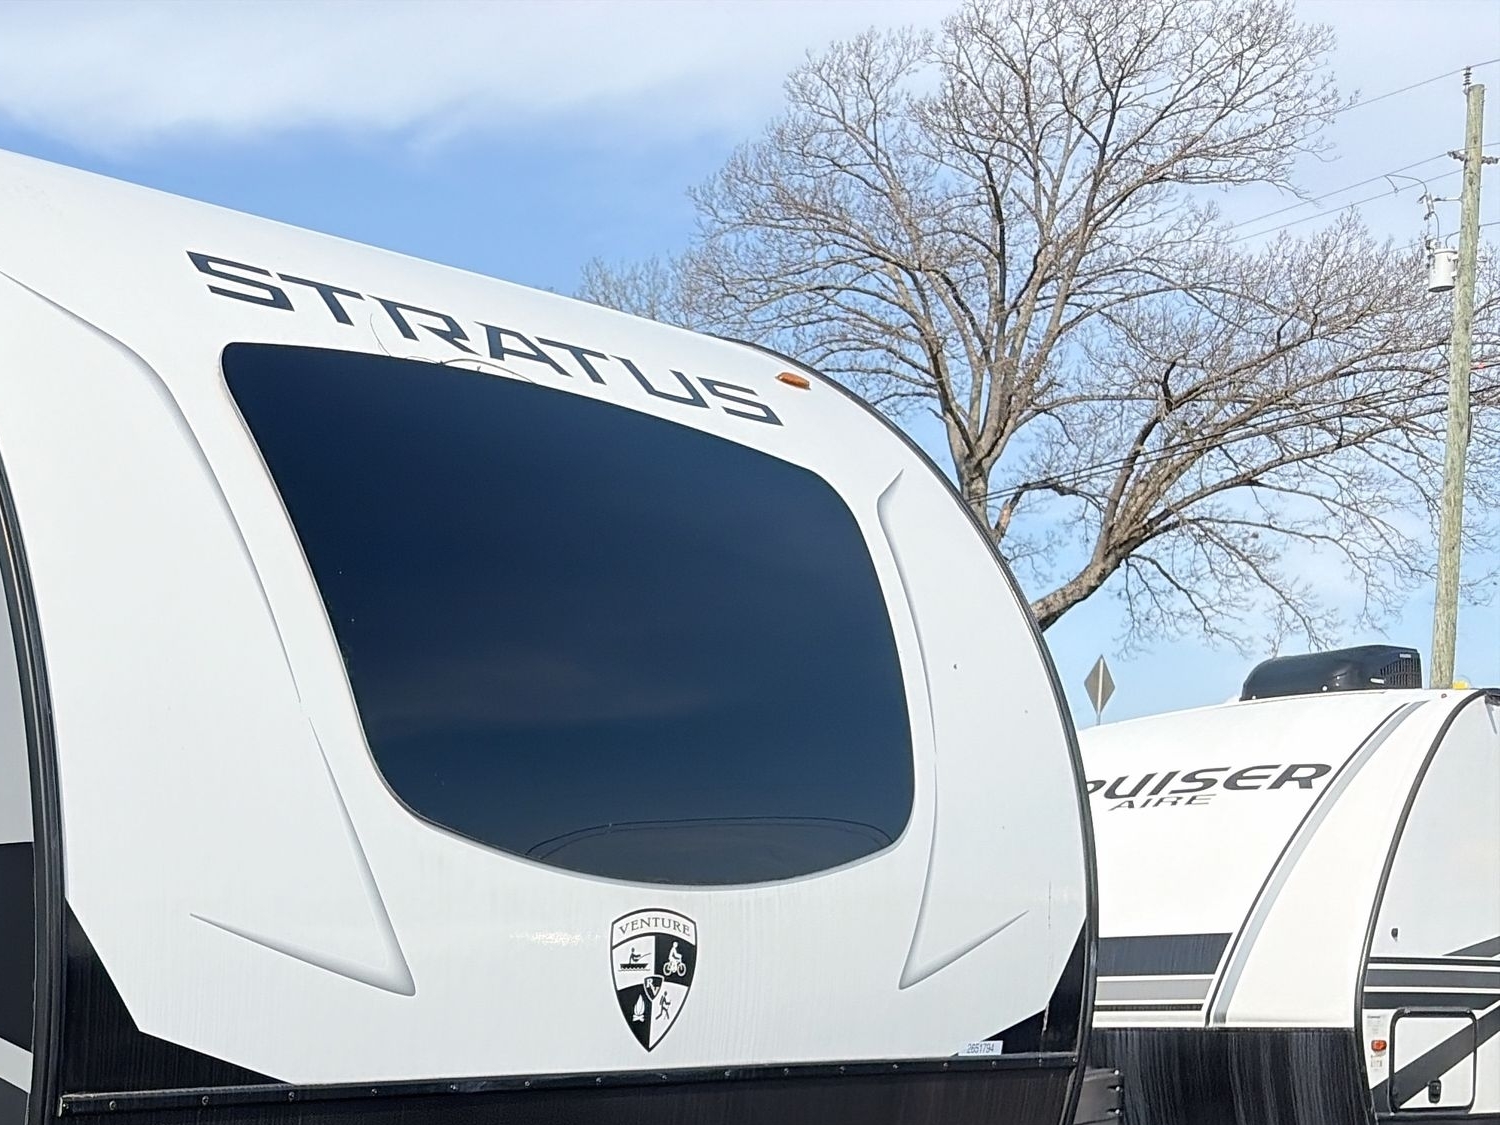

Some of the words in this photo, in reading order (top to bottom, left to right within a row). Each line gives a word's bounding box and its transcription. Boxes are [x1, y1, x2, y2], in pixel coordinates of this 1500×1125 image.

[186, 250, 784, 427] STRATUS
[1107, 793, 1217, 811] AIRE
[619, 917, 691, 937] VENTURE
